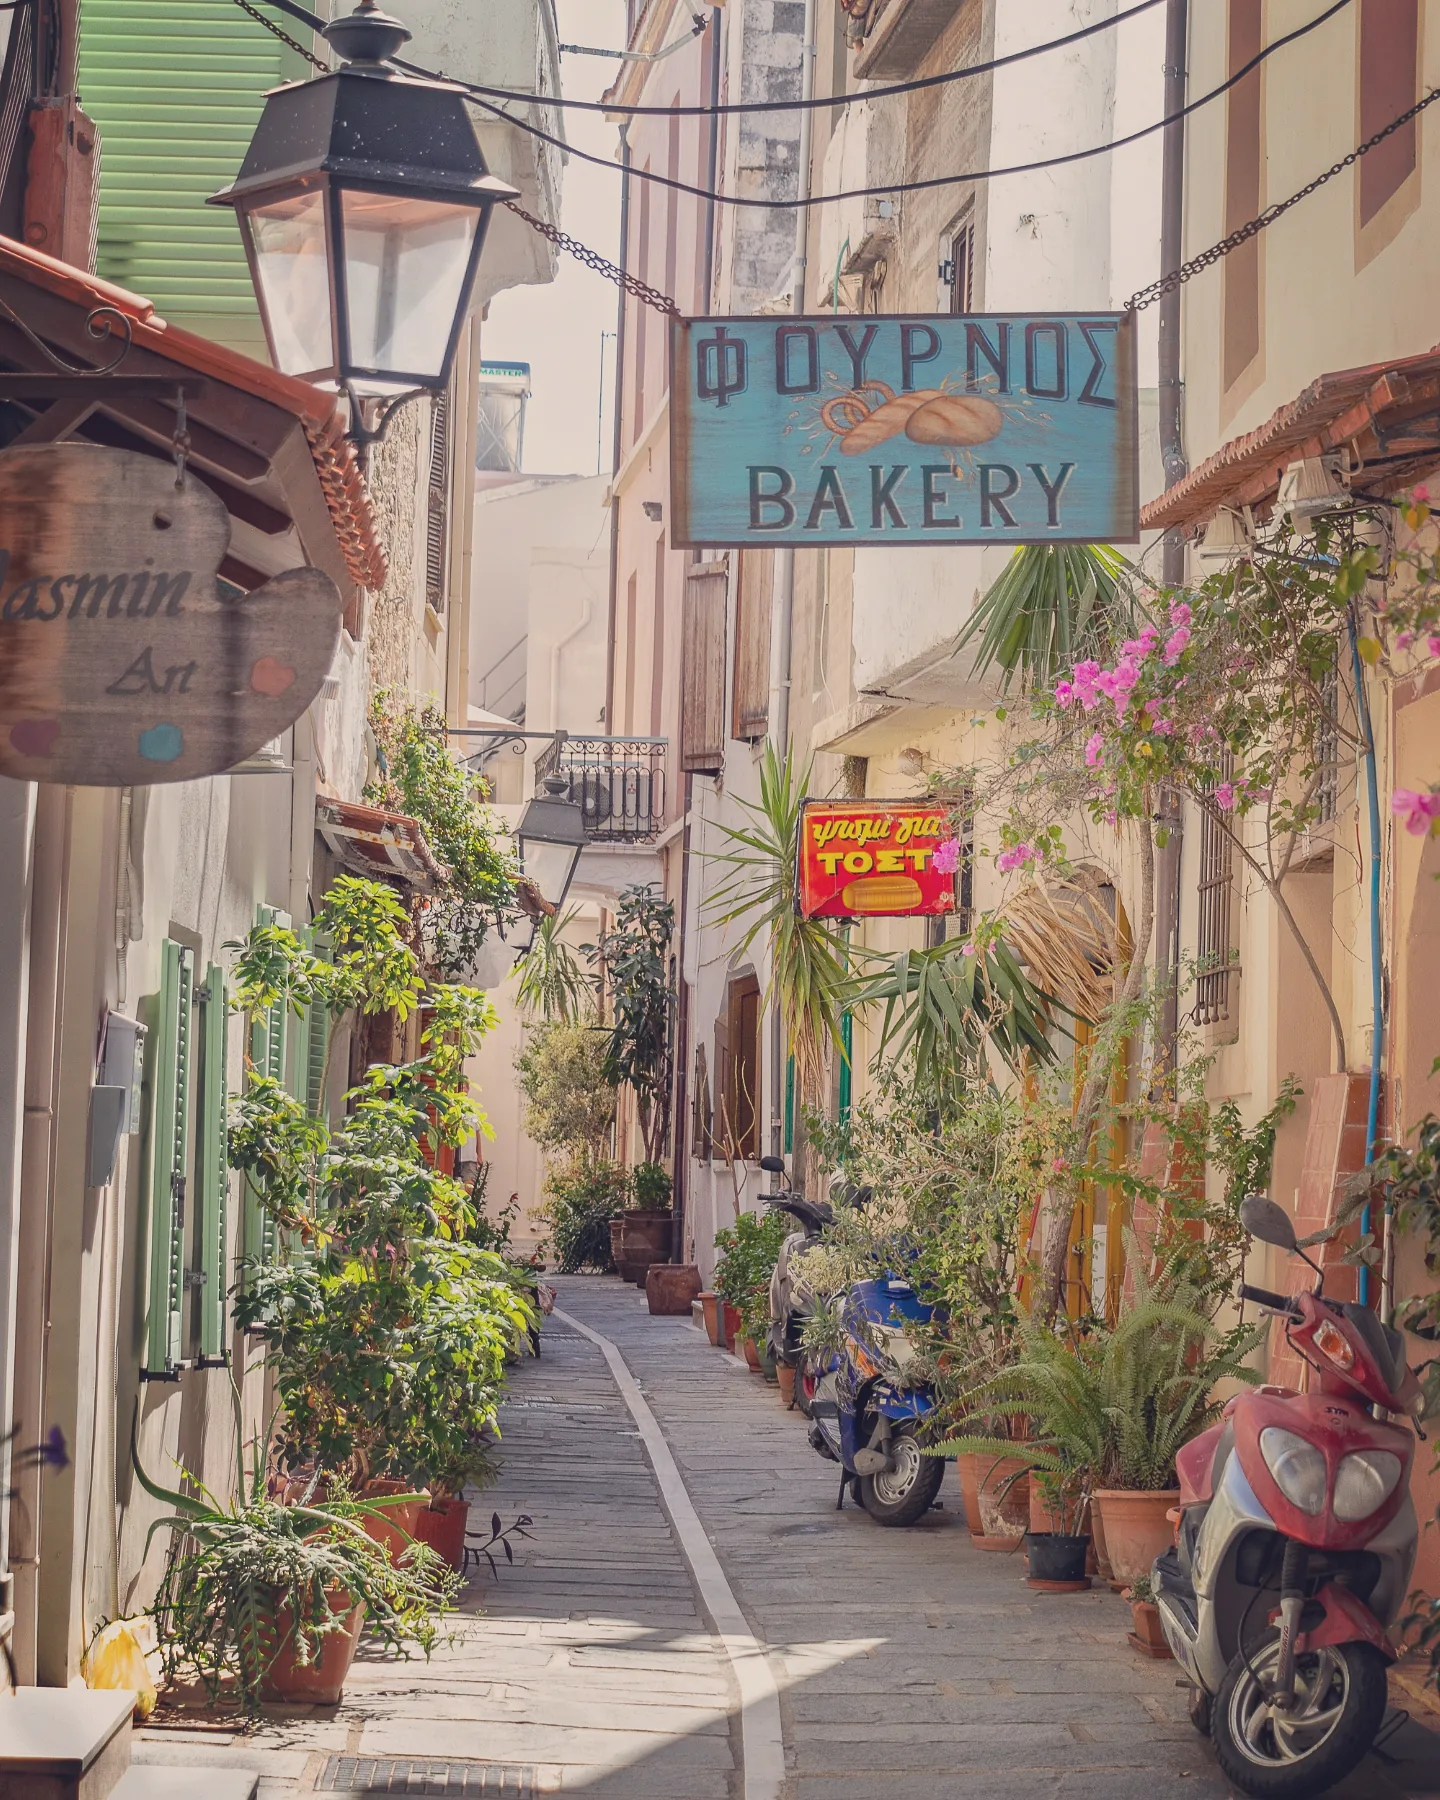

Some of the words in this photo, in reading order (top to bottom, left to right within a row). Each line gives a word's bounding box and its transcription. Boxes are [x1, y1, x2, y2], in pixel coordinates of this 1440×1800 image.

[697, 321, 1119, 409] ΦΟΥΡΝΟΣ
[746, 463, 1077, 530] BAKERY
[105, 645, 199, 695] Art
[816, 849, 934, 875] ΤΟΣΤ
